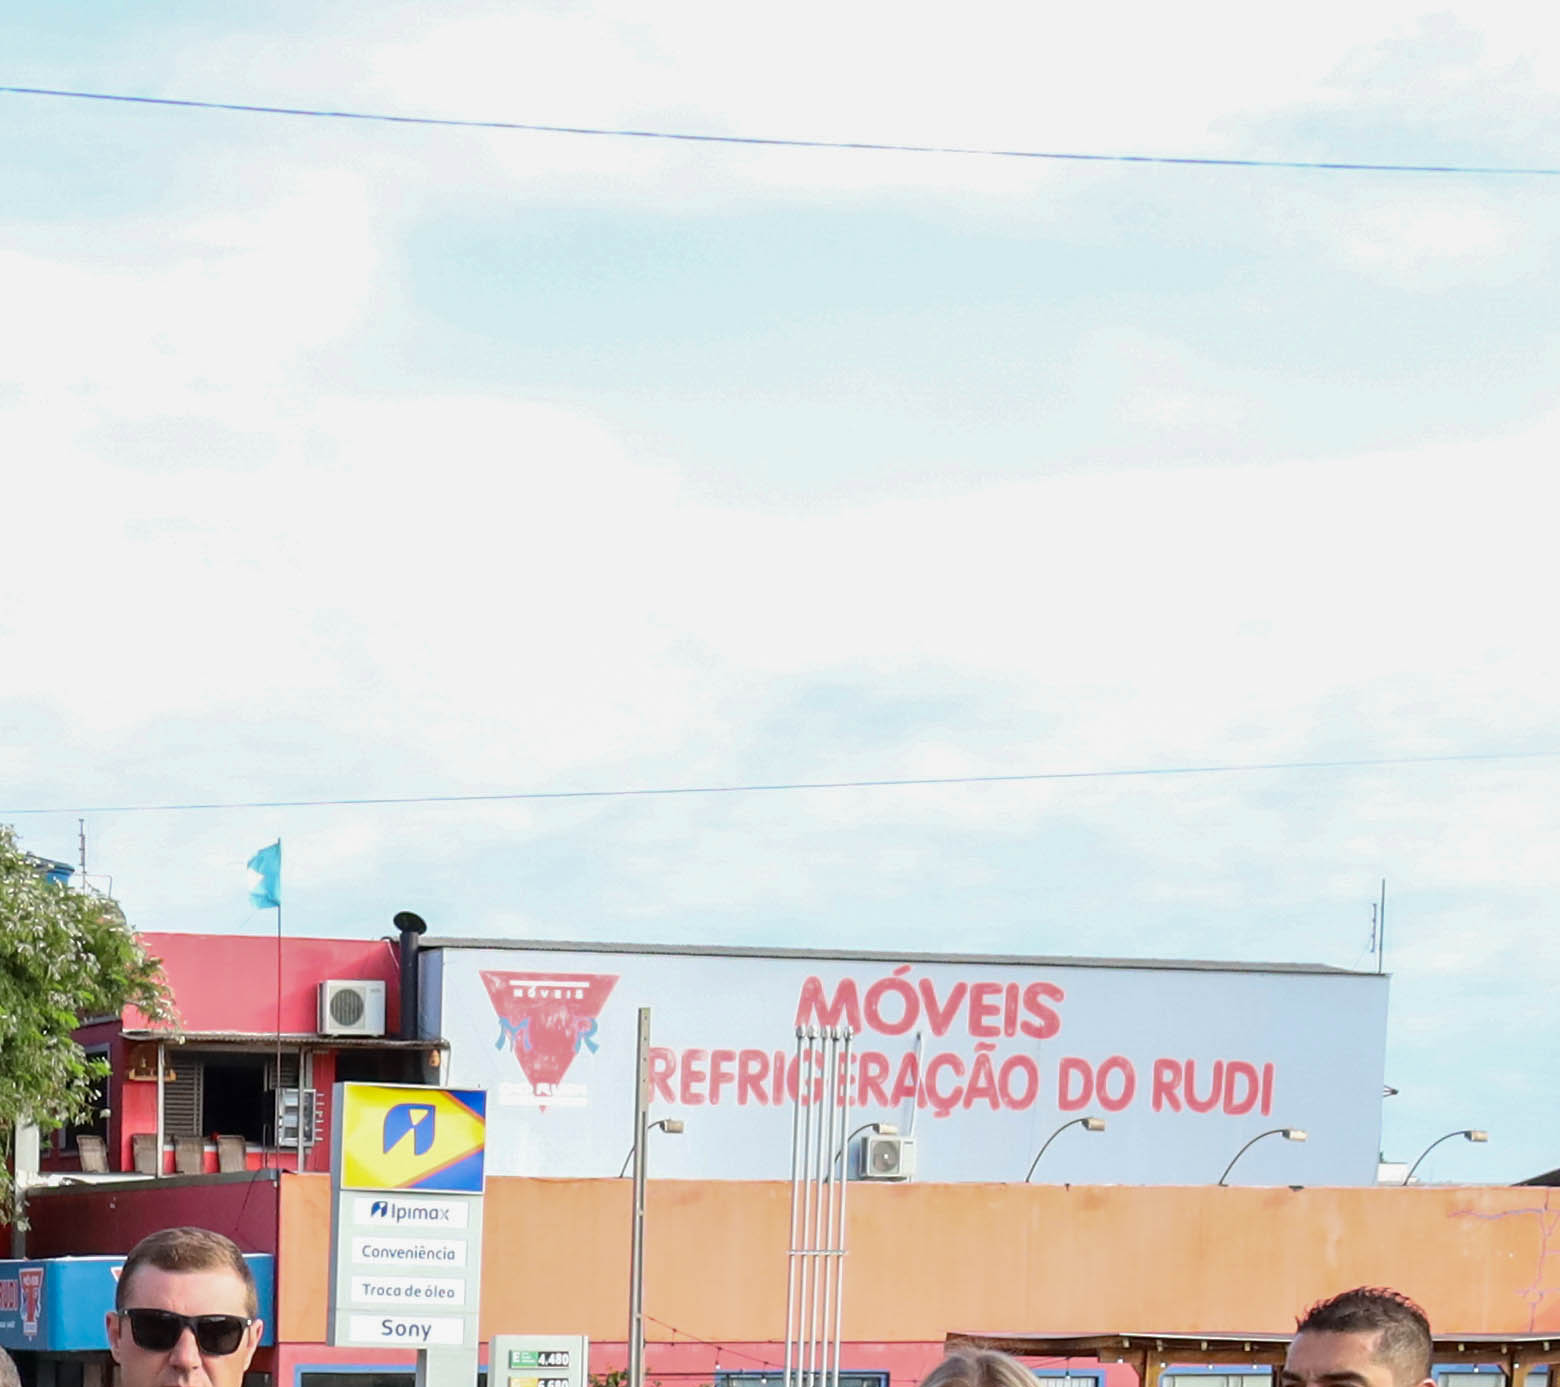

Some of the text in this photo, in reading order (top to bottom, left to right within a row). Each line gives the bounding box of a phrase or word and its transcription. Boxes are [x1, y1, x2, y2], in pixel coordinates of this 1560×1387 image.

[795, 965, 1063, 1038] MÓVEIS
[647, 1042, 1274, 1118] REFRIGERAÇÃO DO RUDI
[362, 1245, 456, 1261] Conveniência
[363, 1283, 455, 1299] Troca de óleo
[381, 1319, 432, 1342] Sony
[538, 1354, 569, 1366] 4.480
